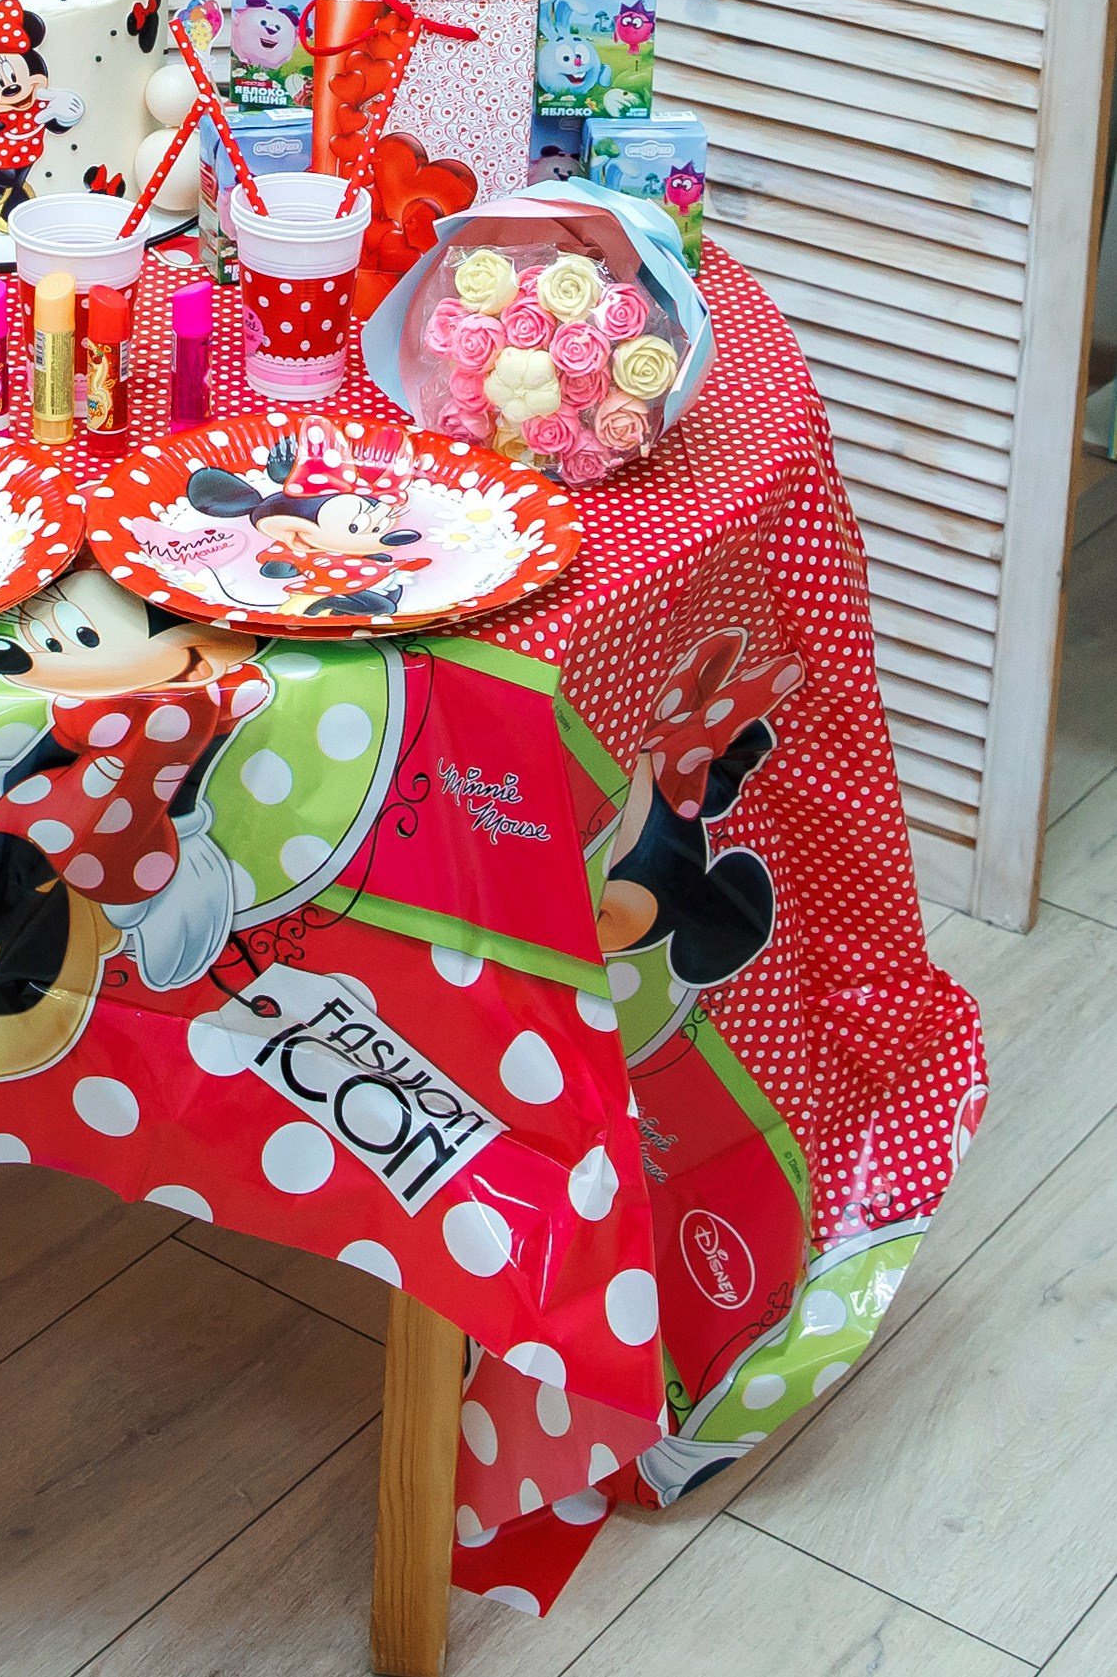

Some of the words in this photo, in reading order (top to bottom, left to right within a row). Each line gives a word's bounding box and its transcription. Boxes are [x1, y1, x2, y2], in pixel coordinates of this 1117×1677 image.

[242, 93, 288, 105] ВИШНЯ
[540, 107, 593, 117] ЯБЛОКО
[140, 529, 234, 561] Minnie
[437, 757, 522, 804] Minnie
[465, 798, 551, 844] Mouse
[322, 996, 490, 1151] FASHION
[253, 1024, 458, 1201] ICON
